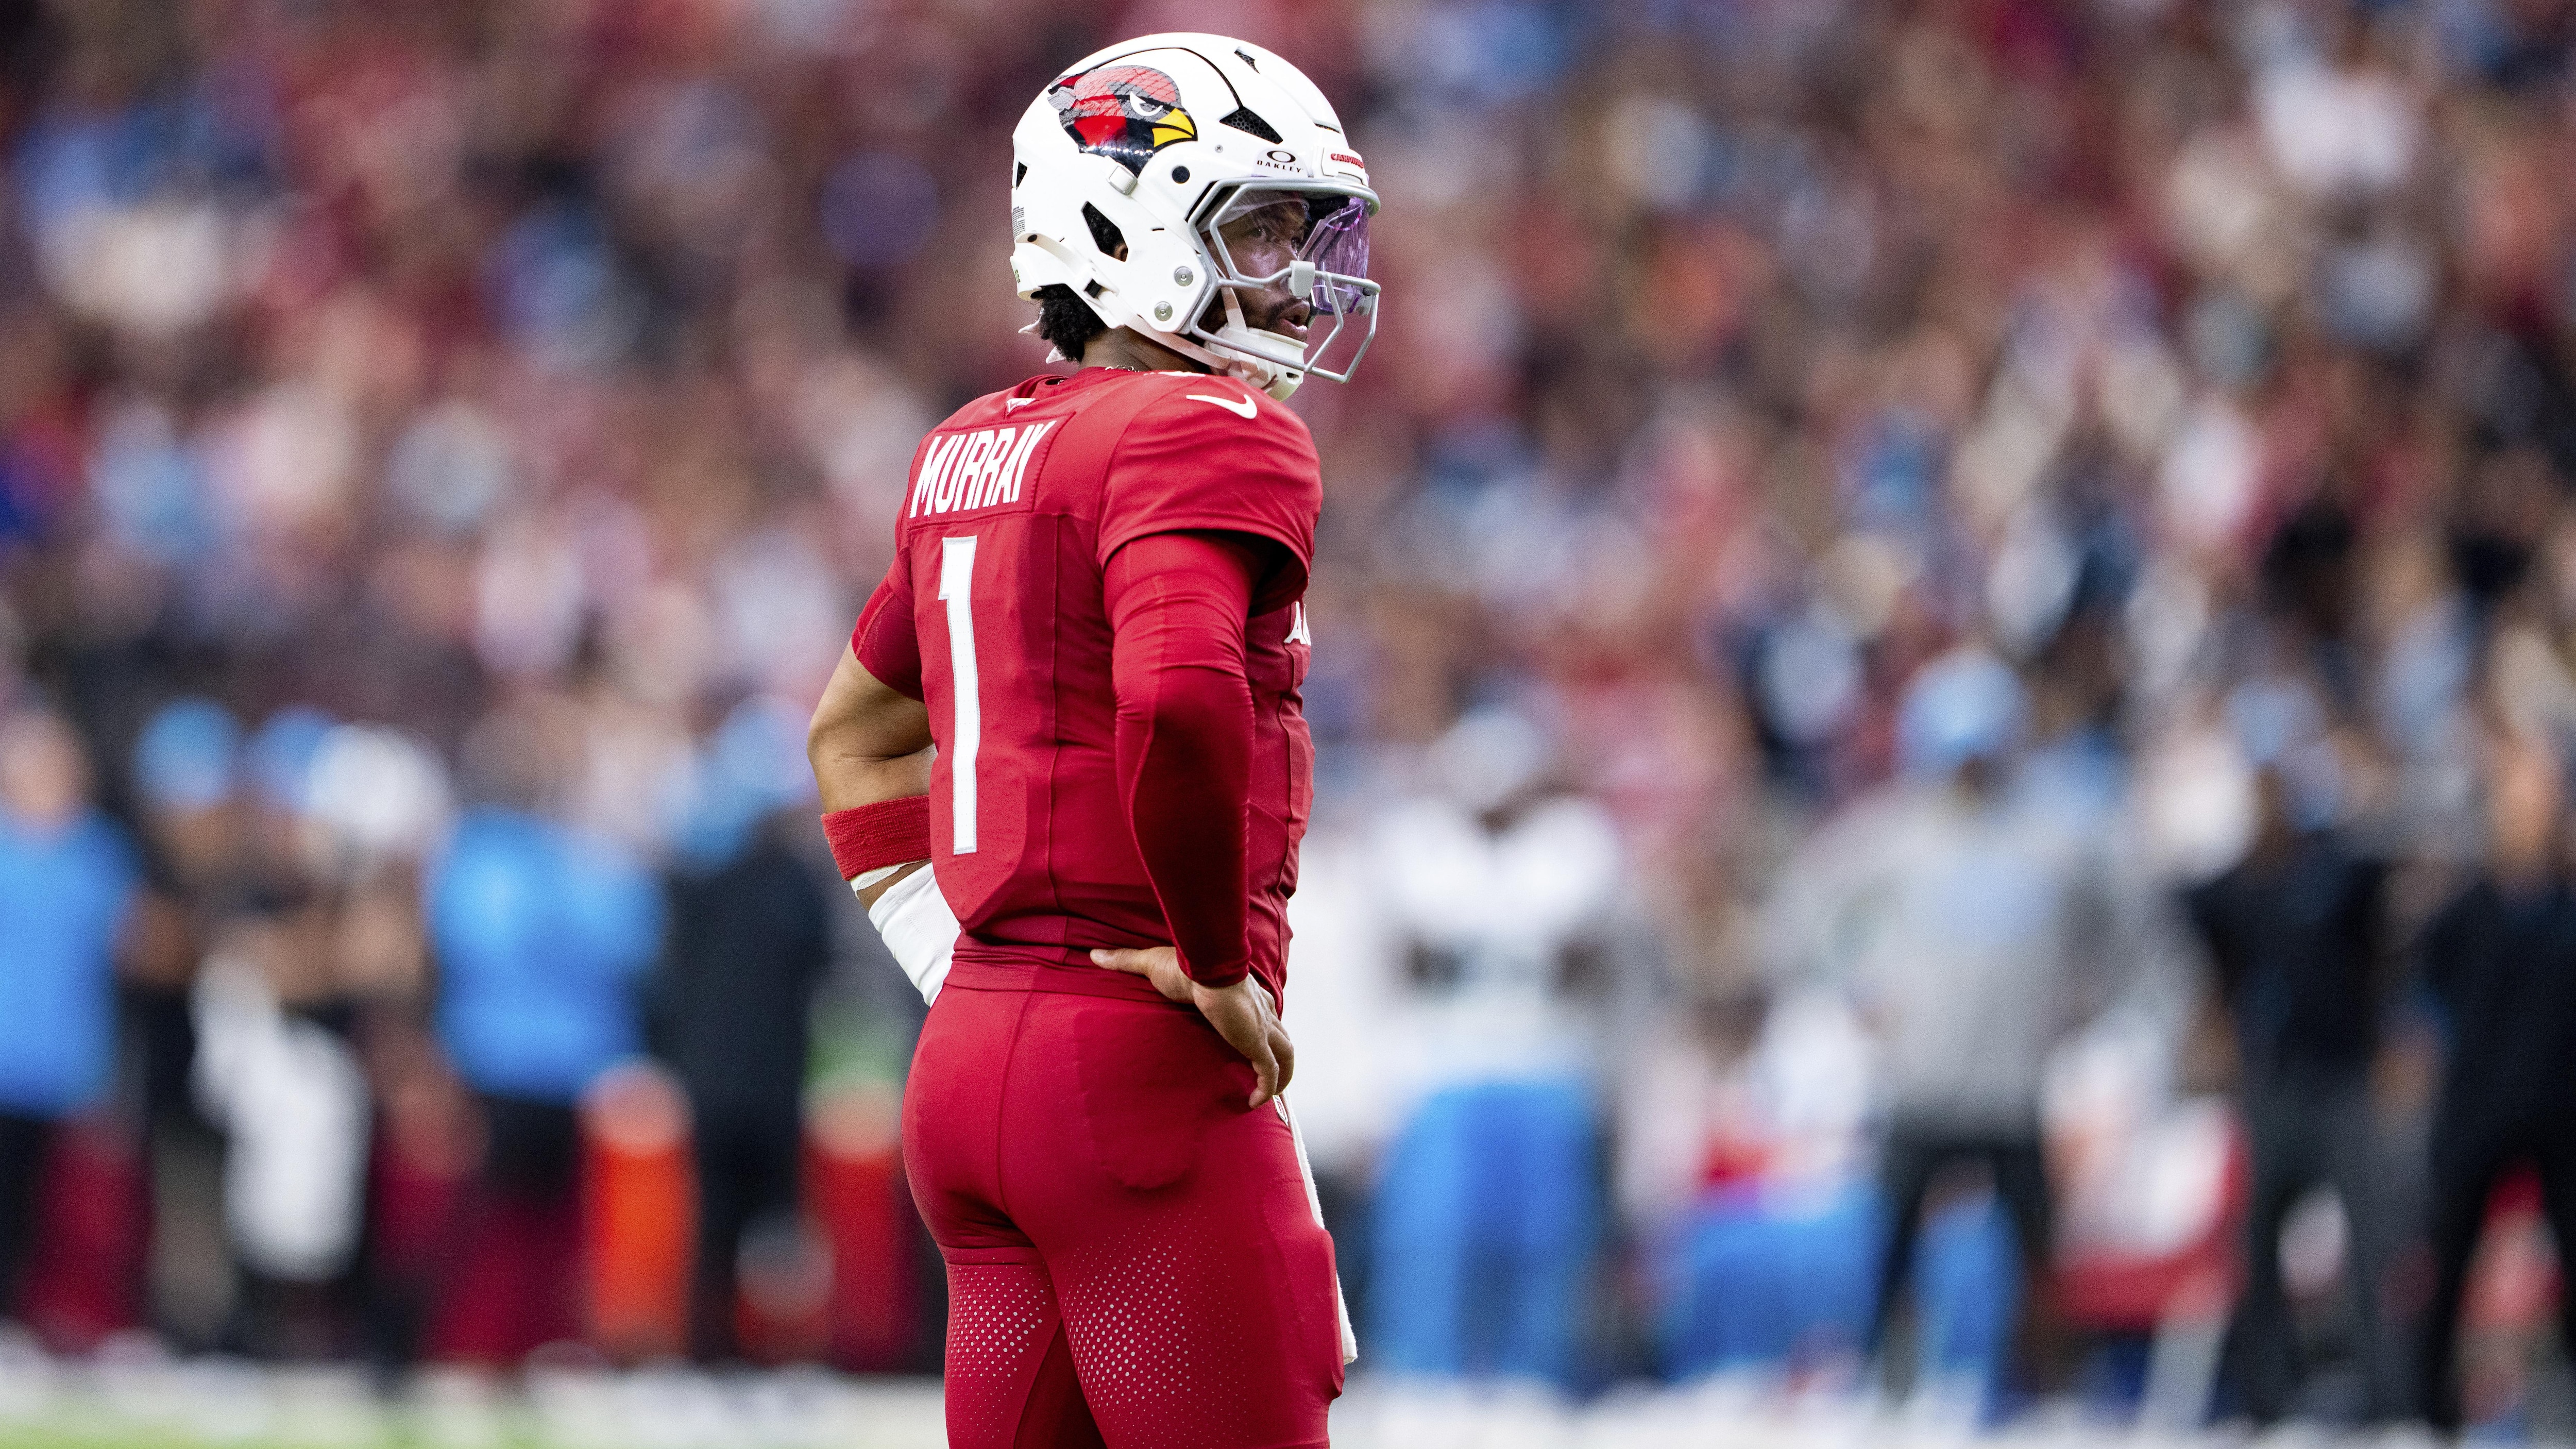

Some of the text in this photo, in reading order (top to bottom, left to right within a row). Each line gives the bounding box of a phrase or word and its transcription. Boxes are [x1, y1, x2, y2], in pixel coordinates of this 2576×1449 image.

[1257, 160, 1301, 173] OAKLEY
[909, 420, 1057, 518] MURRAY
[938, 535, 980, 855] 1
